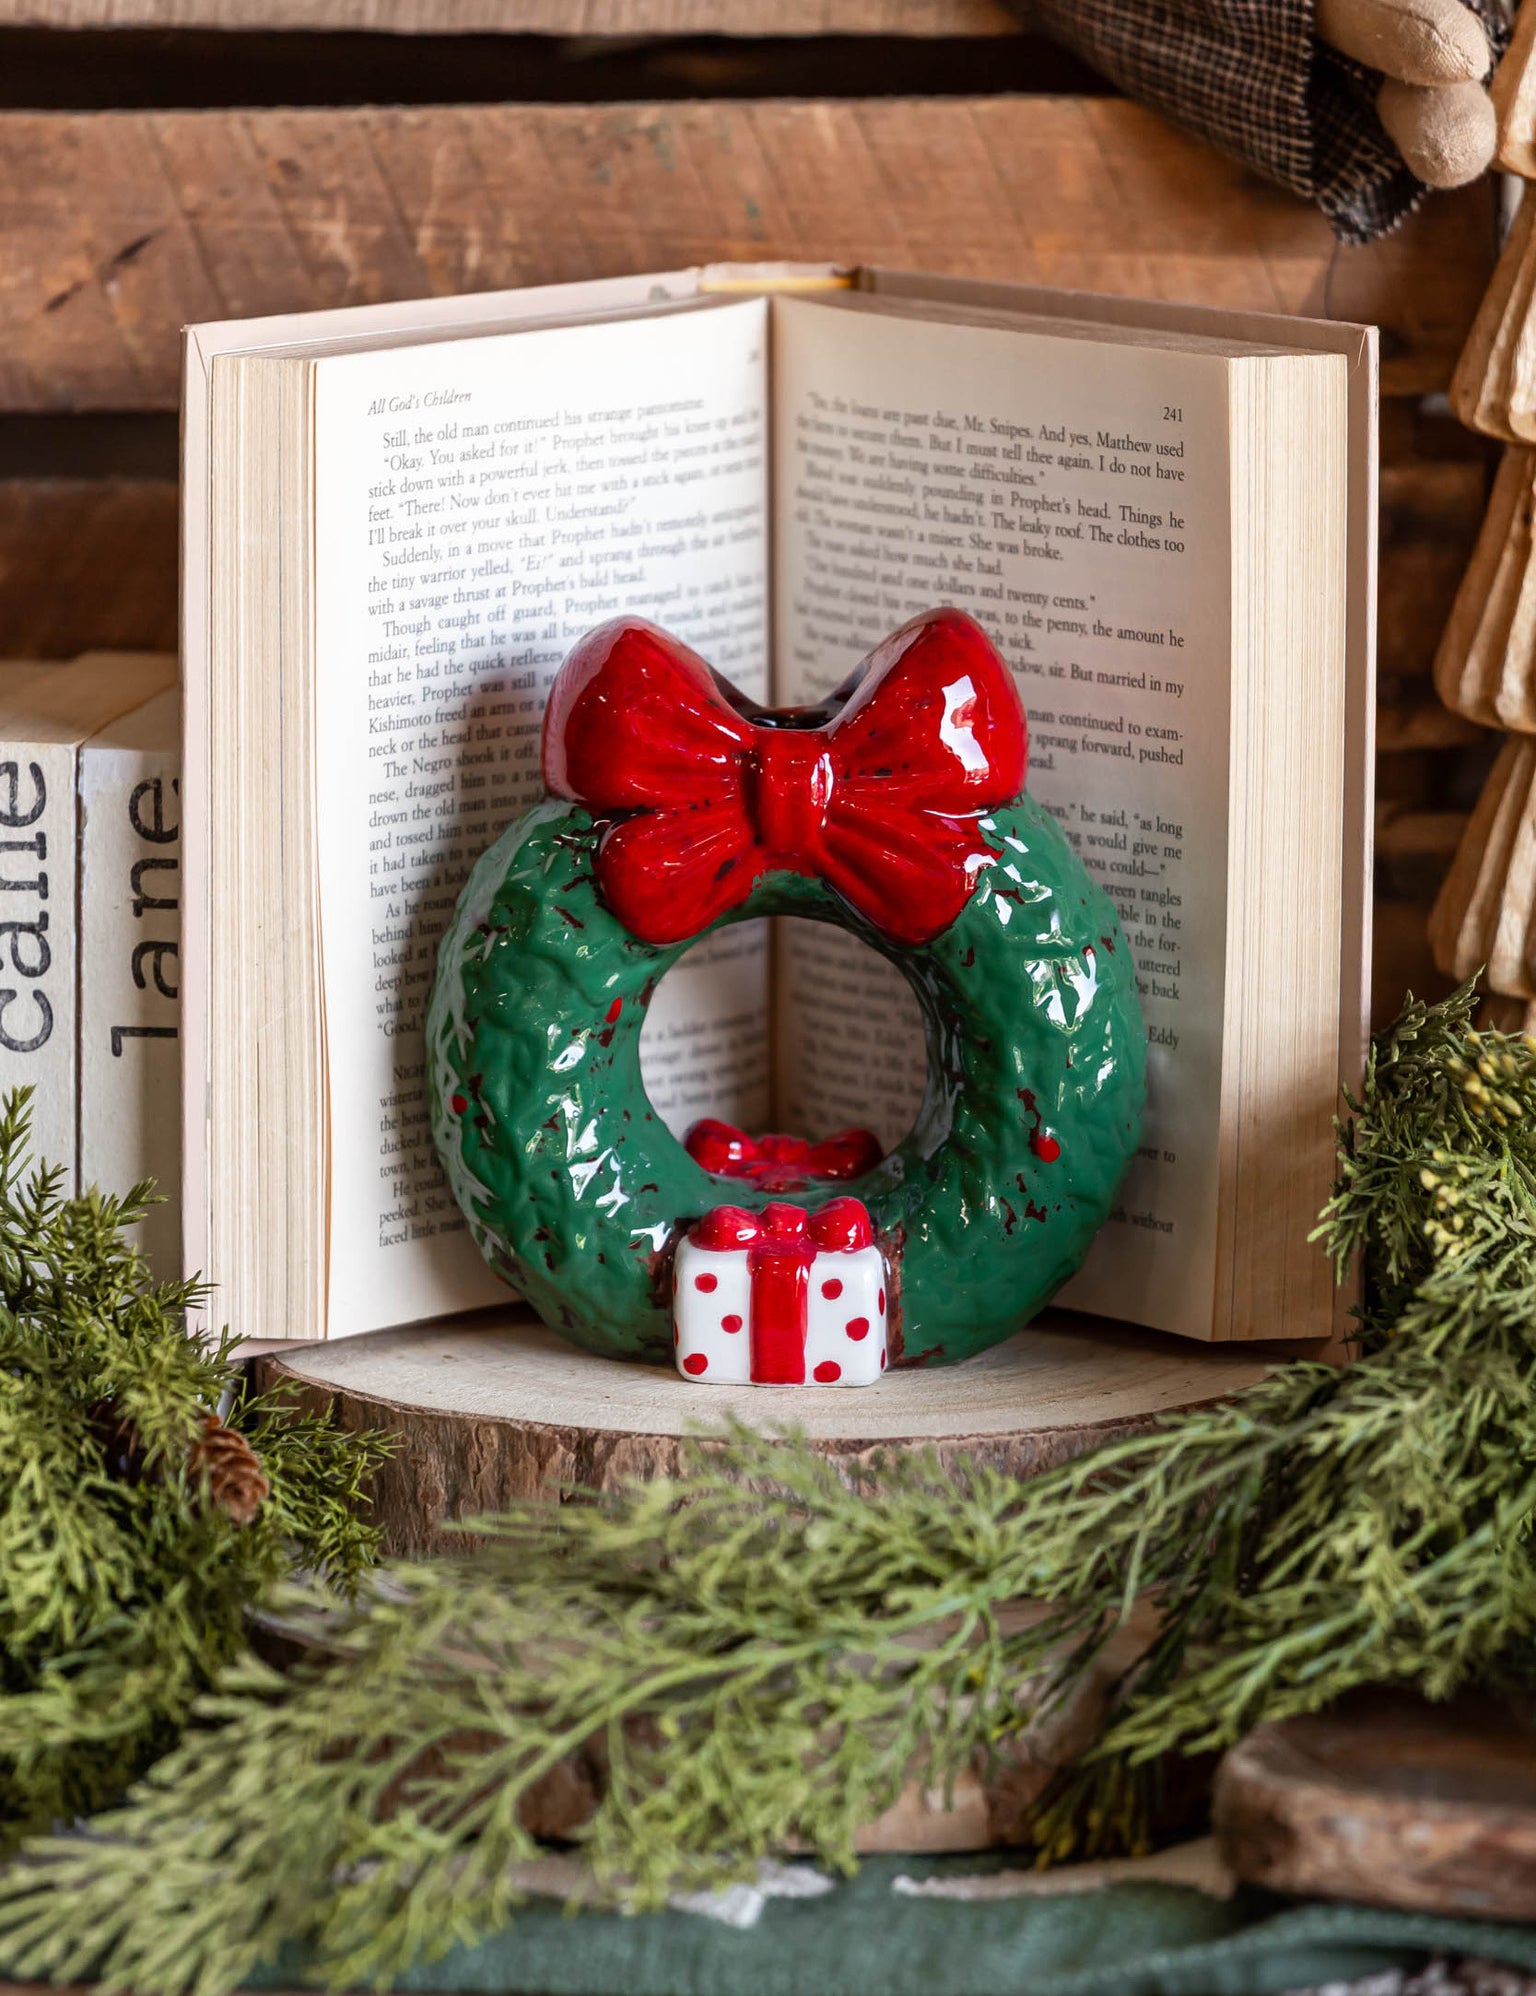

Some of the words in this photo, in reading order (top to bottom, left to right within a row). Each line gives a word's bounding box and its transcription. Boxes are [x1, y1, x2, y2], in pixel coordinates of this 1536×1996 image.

[368, 399, 385, 415] All
[389, 394, 420, 413] God's
[424, 389, 472, 408] Children
[1163, 407, 1183, 422] 241
[383, 430, 410, 448] Still,
[414, 427, 433, 444] the
[437, 422, 457, 440] old
[462, 424, 489, 438] man
[494, 411, 559, 433] continued
[989, 417, 1033, 439] Snipes.
[1038, 424, 1065, 442] And
[1069, 431, 1092, 448] yes,
[1097, 431, 1152, 453] Matthew
[1156, 442, 1184, 457] used
[430, 449, 454, 465] You
[459, 441, 494, 462] asked
[500, 439, 518, 456] for
[1002, 444, 1021, 460] tell
[1026, 446, 1053, 464] thee
[1057, 453, 1093, 471] again.
[1099, 455, 1104, 471] I
[1109, 457, 1126, 473] do
[1130, 464, 1152, 477] not
[1156, 462, 1185, 481] have
[368, 479, 396, 499] stick
[400, 477, 433, 493] down
[437, 470, 464, 487] with
[480, 461, 538, 487] powerful
[368, 505, 393, 522] feet.
[450, 495, 479, 510] Now
[522, 487, 550, 500] ever
[991, 490, 1003, 504] in
[1011, 491, 1071, 514] Prophet's
[1078, 499, 1111, 519] head.
[1119, 505, 1162, 529] Things
[1169, 511, 1185, 528] he
[369, 528, 385, 545] I'll
[389, 523, 422, 543] break
[427, 522, 435, 536] it
[440, 521, 466, 535] over
[472, 516, 500, 534] your
[991, 512, 1016, 530] The
[1019, 515, 1051, 538] leaky
[1055, 522, 1084, 539] roof.
[1089, 524, 1113, 543] The
[1117, 529, 1160, 550] clothes
[1164, 539, 1185, 552] too
[383, 544, 443, 567] Suddenly,
[448, 545, 460, 558] in
[466, 546, 472, 555] a
[478, 540, 513, 553] move
[518, 531, 545, 548] that
[552, 526, 605, 546] Prophet
[969, 533, 992, 550] She
[996, 543, 1019, 554] was
[1023, 539, 1063, 560] broke.
[368, 577, 388, 592] the
[392, 572, 415, 590] tiny
[420, 567, 465, 585] warrior
[559, 553, 583, 567] and
[368, 599, 394, 616] with
[399, 602, 405, 611] a
[410, 594, 449, 611] savage
[453, 588, 490, 603] thrust
[495, 586, 506, 597] at
[512, 576, 575, 596] Prophet's
[980, 583, 1003, 599] and
[1007, 588, 1049, 608] twenty
[1053, 595, 1095, 610] cents."
[383, 615, 431, 639] Though
[438, 610, 480, 635] caught
[488, 606, 505, 622] off
[513, 604, 556, 626] guard,
[1023, 612, 1042, 628] the
[1047, 619, 1088, 636] penny,
[1093, 620, 1112, 637] the
[1117, 629, 1164, 645] amount
[1169, 630, 1185, 647] he
[368, 644, 410, 664] midair,
[415, 641, 455, 656] feeling
[461, 635, 485, 649] that
[491, 630, 506, 645] he
[511, 629, 536, 643] was
[542, 624, 557, 639] all
[368, 669, 391, 687] that
[397, 666, 411, 682] he
[416, 663, 439, 680] had
[444, 659, 464, 674] the
[469, 653, 505, 672] quick
[511, 650, 563, 667] reflexes
[1070, 664, 1094, 682] But
[1097, 669, 1146, 689] married
[1151, 676, 1161, 691] in
[1166, 682, 1184, 698] my
[368, 693, 414, 711] heavier,
[422, 683, 472, 704] Prophet
[480, 681, 504, 693] was
[369, 712, 431, 733] Kishimoto
[435, 705, 466, 722] freed
[1059, 712, 1123, 733] continued
[1128, 720, 1141, 734] to
[1145, 725, 1183, 741] exam-
[369, 739, 396, 757] neck
[401, 739, 413, 751] or
[419, 733, 438, 749] the
[442, 727, 471, 744] head
[1036, 735, 1078, 753] sprang
[1082, 736, 1135, 759] forward,
[1139, 747, 1183, 765] pushed
[384, 762, 407, 778] The
[413, 756, 451, 775] Negro
[457, 749, 494, 768] shook
[369, 789, 399, 804] nese,
[405, 776, 454, 799] dragged
[369, 809, 408, 828] drown
[413, 803, 431, 820] the
[435, 800, 455, 816] old
[1081, 805, 1095, 823] he
[1100, 810, 1128, 829] said,
[1134, 813, 1152, 831] "as
[1156, 816, 1183, 839] long
[369, 833, 391, 851] and
[396, 826, 433, 845] tossed
[438, 822, 461, 840] him
[1087, 832, 1127, 850] would
[1132, 839, 1158, 855] give
[1164, 846, 1182, 859] me
[369, 859, 378, 875] it
[383, 854, 405, 872] had
[411, 850, 444, 869] taken
[370, 881, 397, 898] have
[401, 874, 429, 893] been
[1141, 886, 1182, 907] tangles
[386, 903, 400, 919] As
[405, 900, 419, 914] he
[1145, 910, 1157, 926] in
[1162, 912, 1181, 930] the
[372, 925, 412, 944] behind
[1135, 933, 1154, 947] the
[1159, 936, 1180, 952] for-
[373, 949, 412, 968] looked
[1138, 960, 1180, 976] uttered
[375, 972, 401, 991] deep
[1152, 980, 1179, 999] back
[376, 996, 403, 1015] what
[1148, 1025, 1179, 1049] Eddy
[380, 1116, 398, 1132] the
